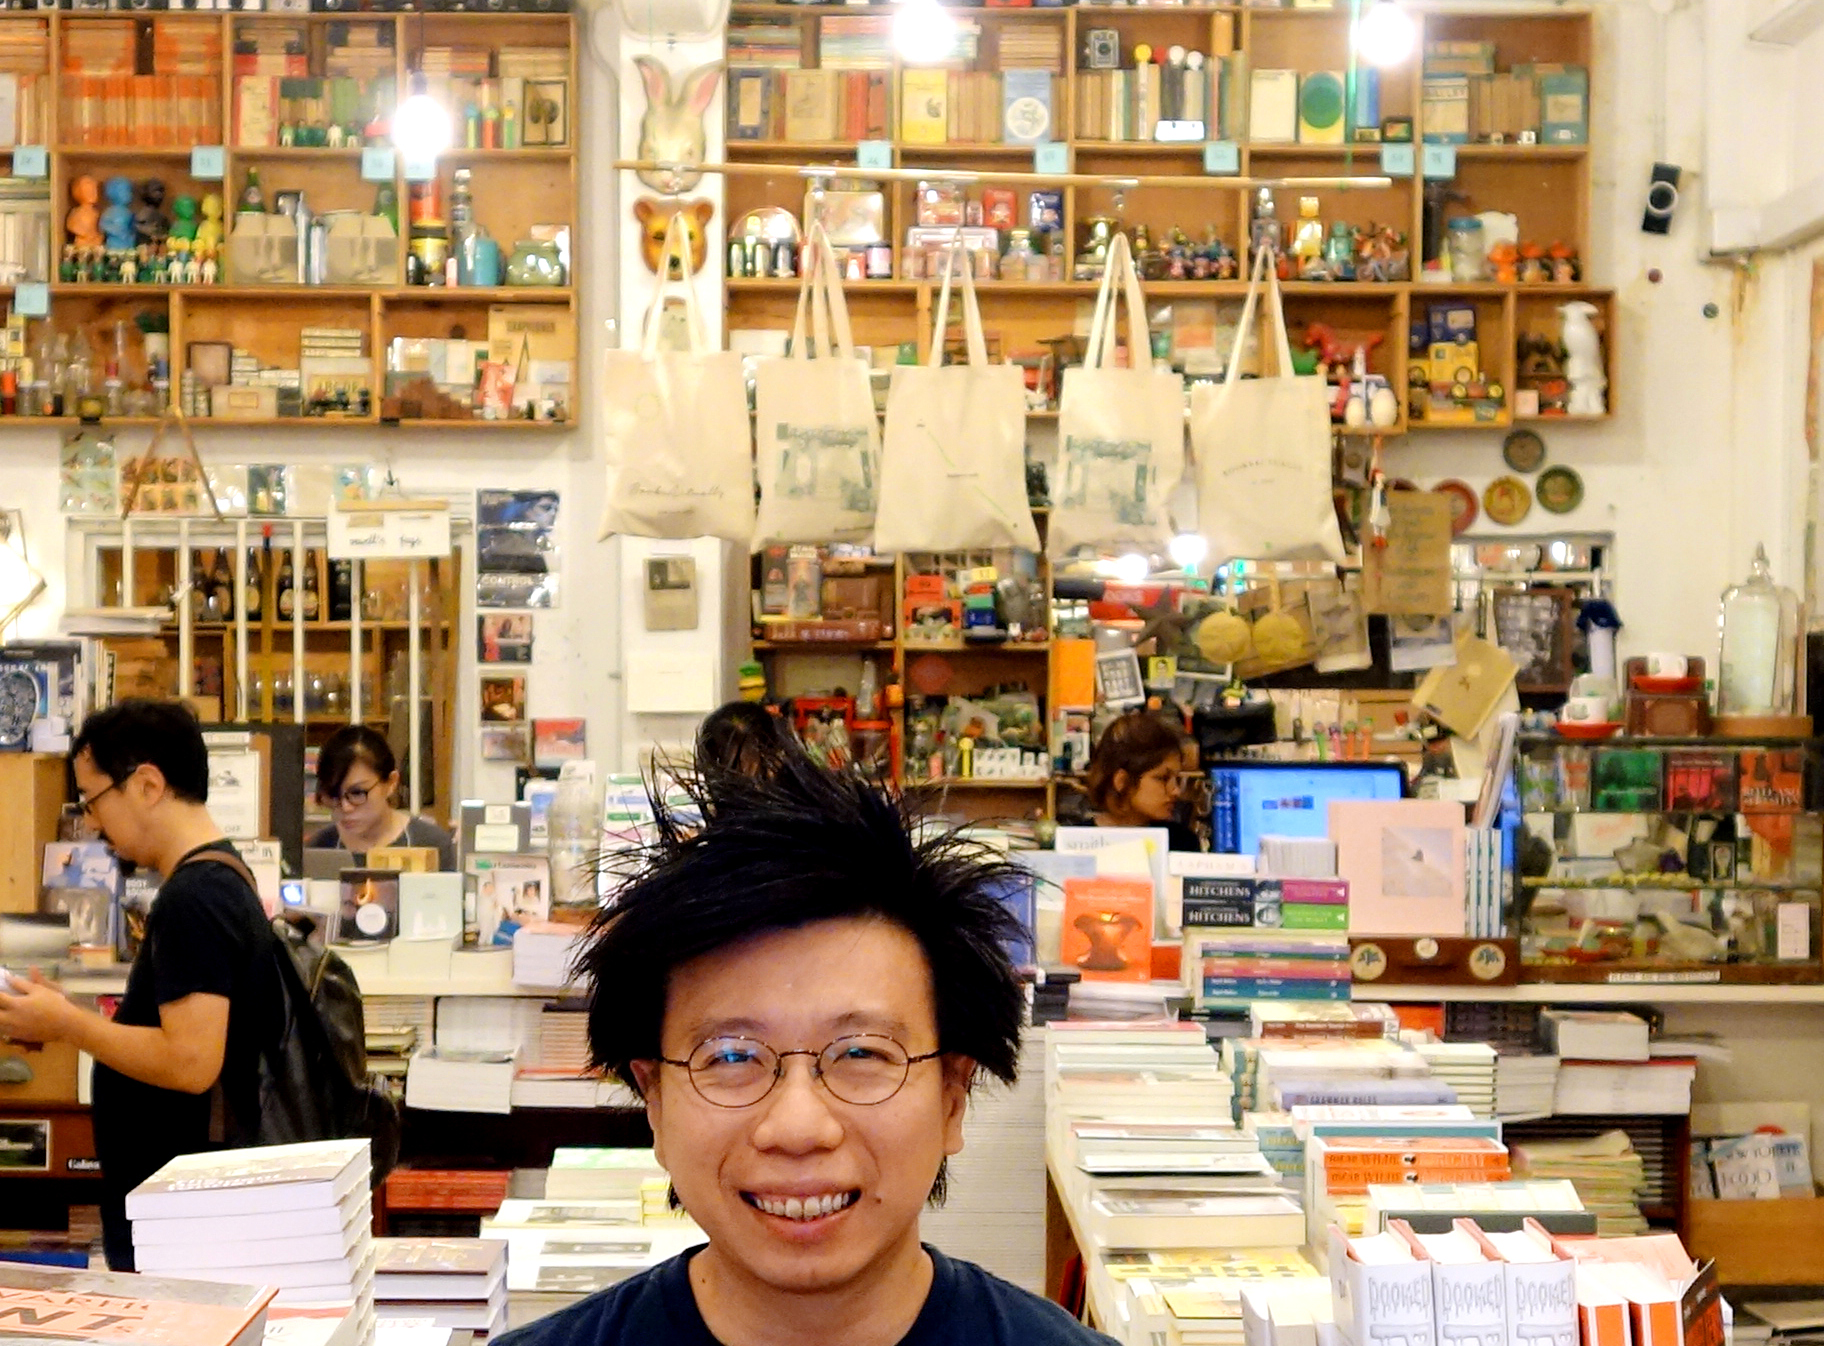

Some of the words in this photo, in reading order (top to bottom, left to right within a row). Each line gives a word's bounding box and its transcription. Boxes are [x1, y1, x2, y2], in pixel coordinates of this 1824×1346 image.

[1188, 885, 1251, 898] HITCHENS
[1188, 910, 1251, 923] HITCHENS
[1368, 1276, 1431, 1317] DOOMED
[1441, 1275, 1505, 1317] DOOMED
[1515, 1275, 1576, 1317] DOOMED
